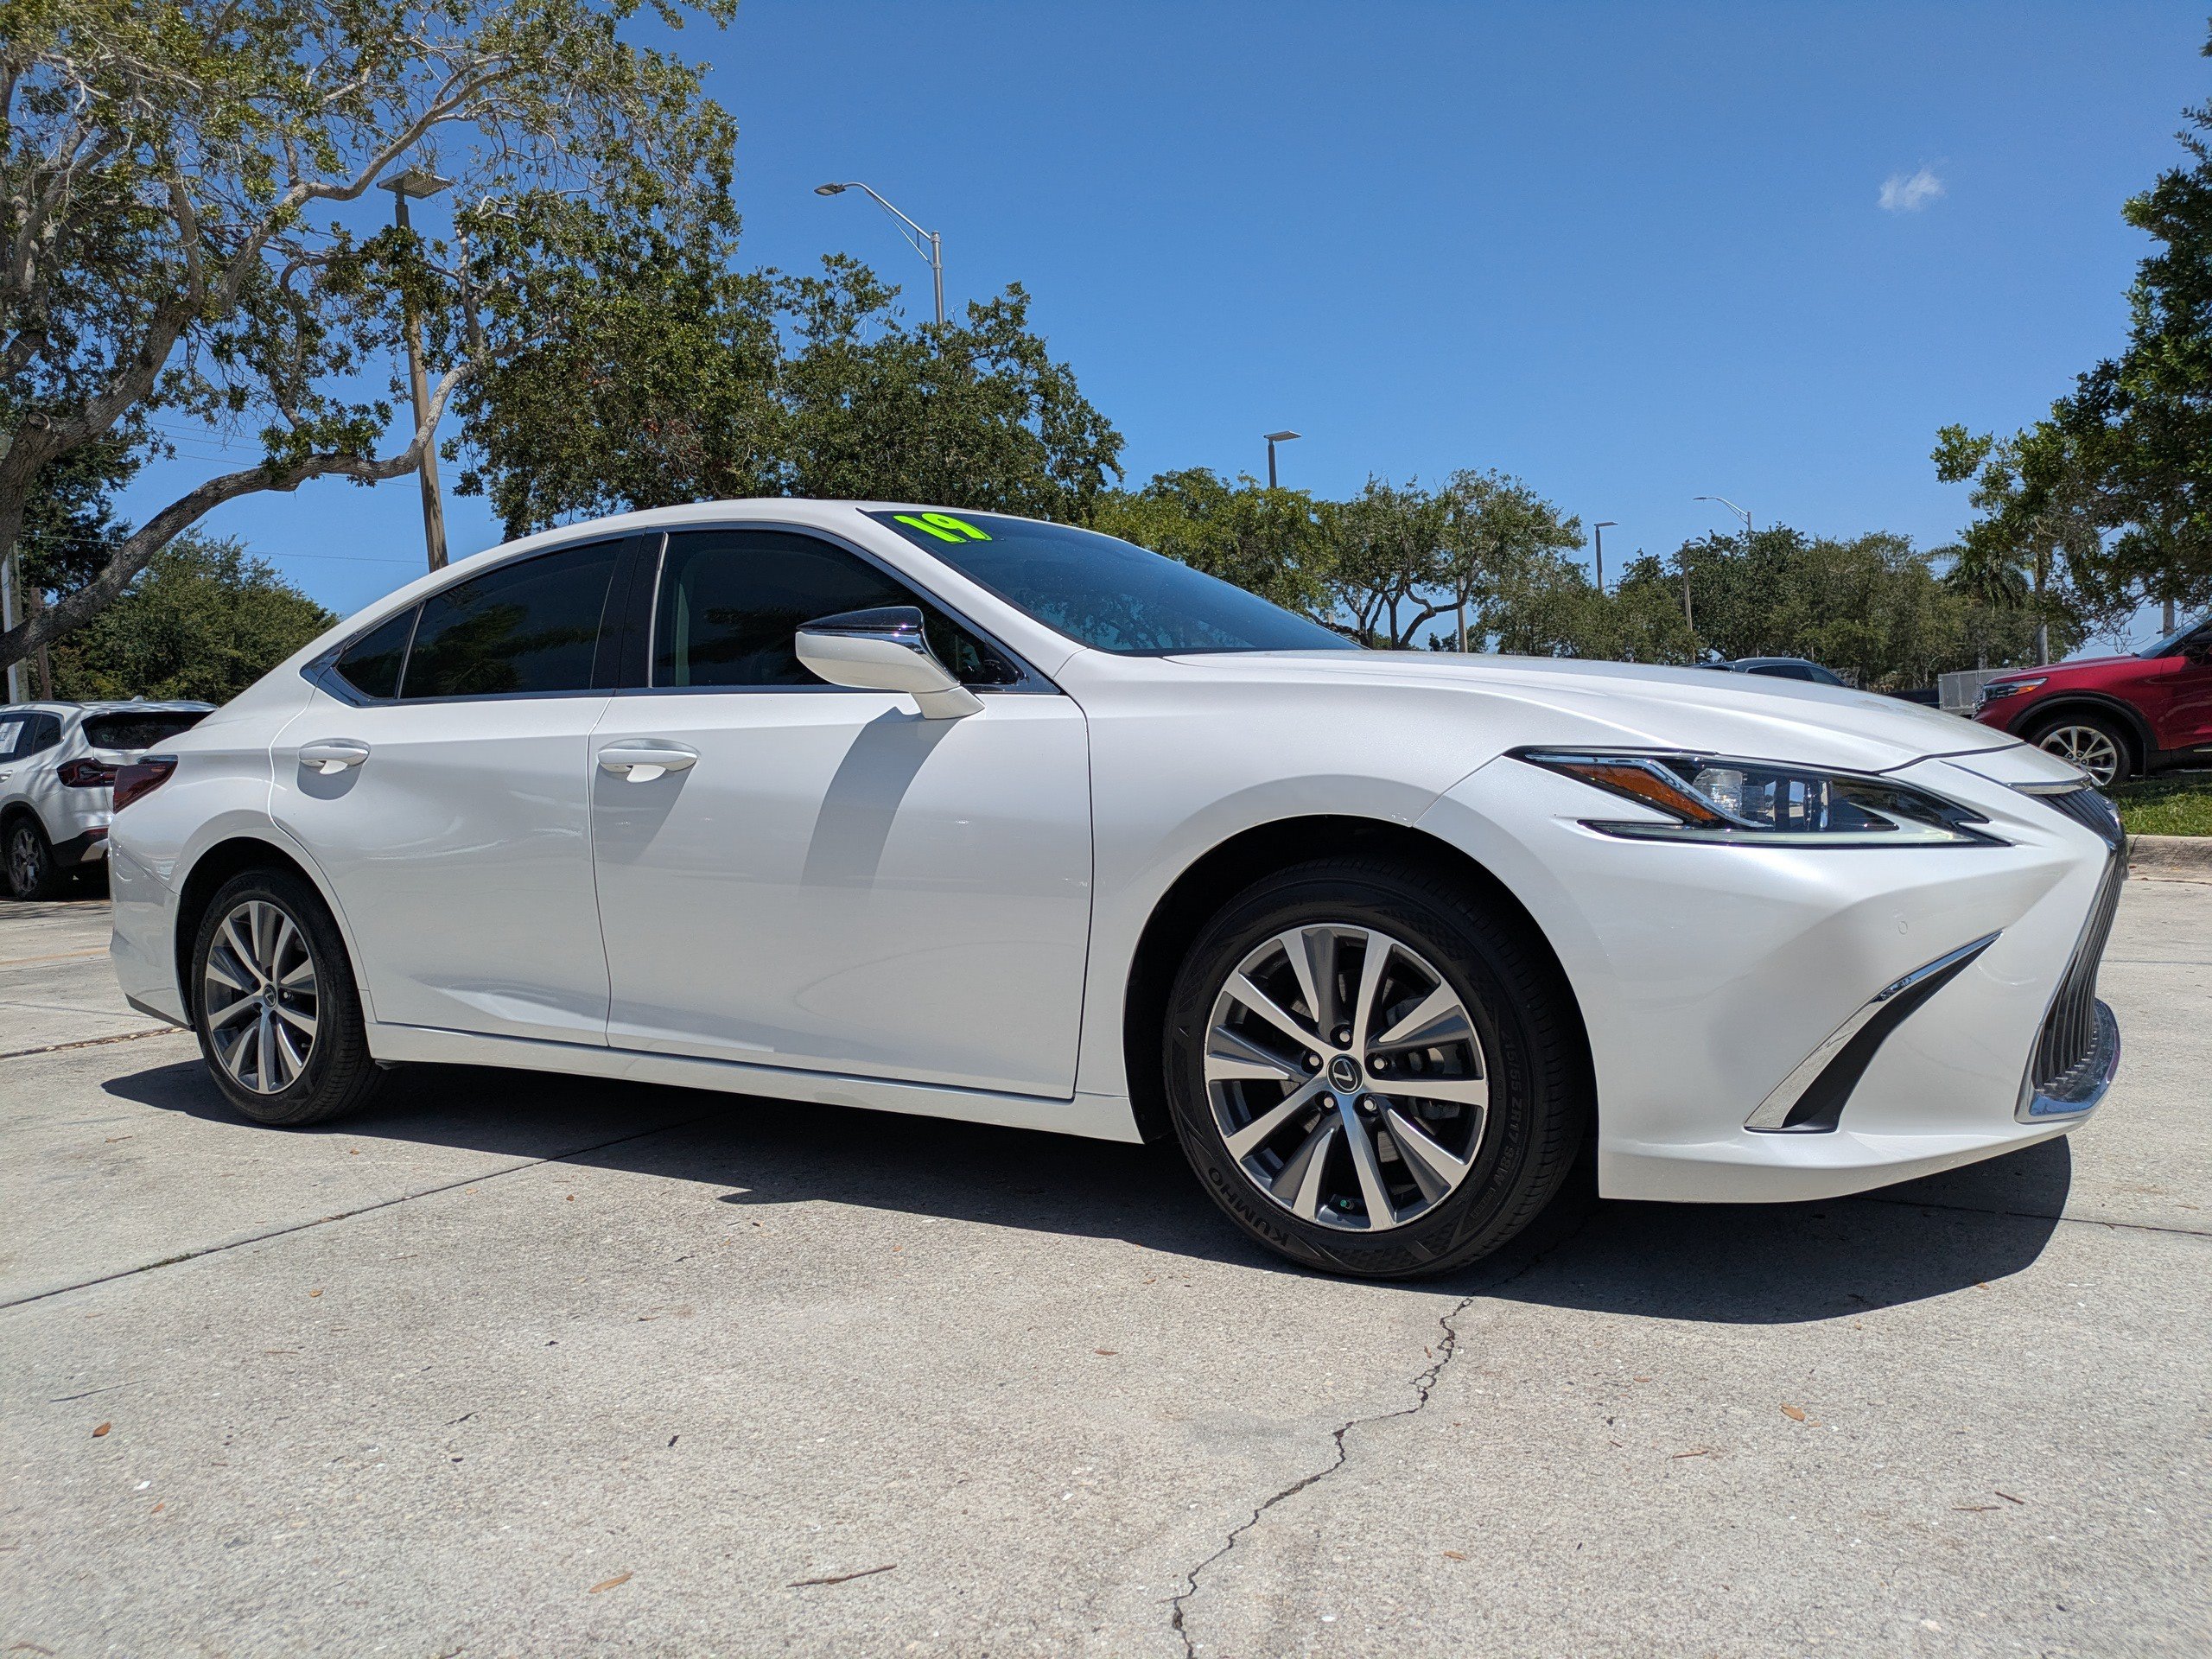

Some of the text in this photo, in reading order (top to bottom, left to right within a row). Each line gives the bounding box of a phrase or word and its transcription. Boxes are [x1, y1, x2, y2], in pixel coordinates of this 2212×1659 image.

[893, 512, 993, 543] 19
[1507, 1096, 1522, 1143] ZR17
[1208, 1166, 1289, 1247] KUMHO
